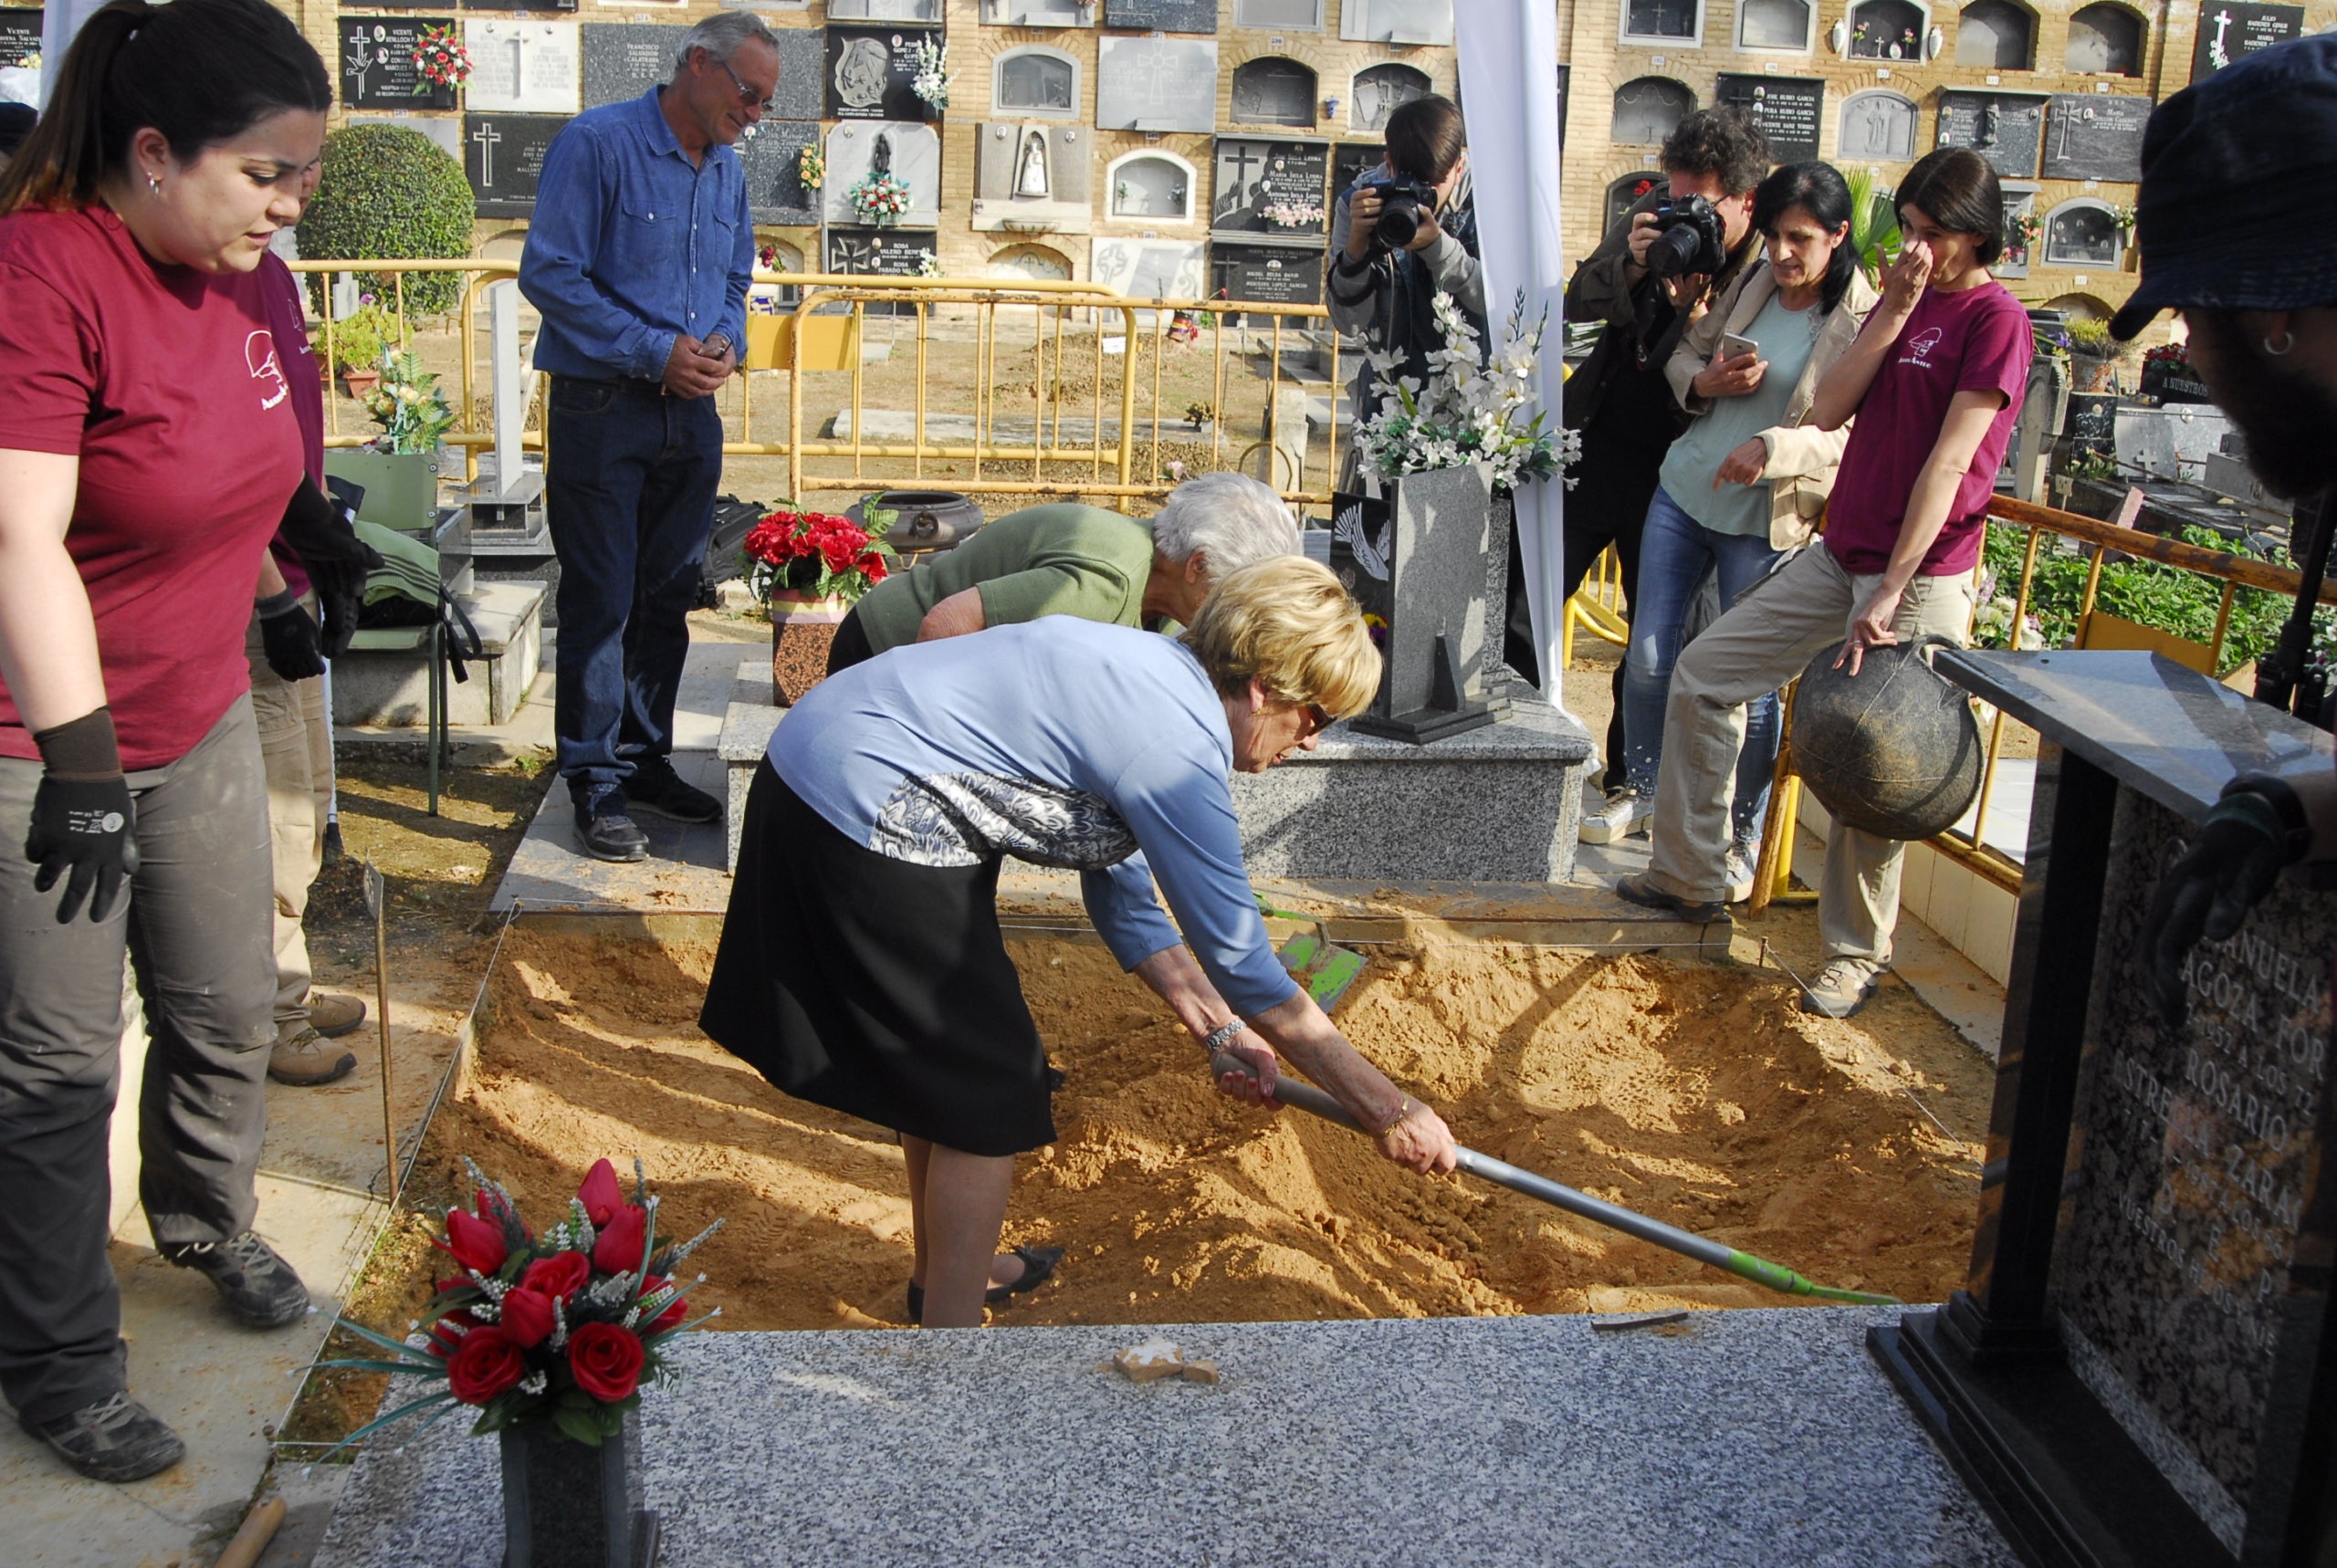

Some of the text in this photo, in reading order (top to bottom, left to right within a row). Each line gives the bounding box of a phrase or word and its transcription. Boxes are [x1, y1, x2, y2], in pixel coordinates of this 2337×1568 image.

[2163, 377, 2208, 397] A NUESTROS
[2180, 949, 2326, 1082] AGOZA FOR
[2203, 929, 2320, 1013] ANUELA
[2113, 1048, 2212, 1157] ESTRELLA
[2185, 1048, 2288, 1151] ROSARIO
[2119, 1190, 2185, 1270] VUESTROS
